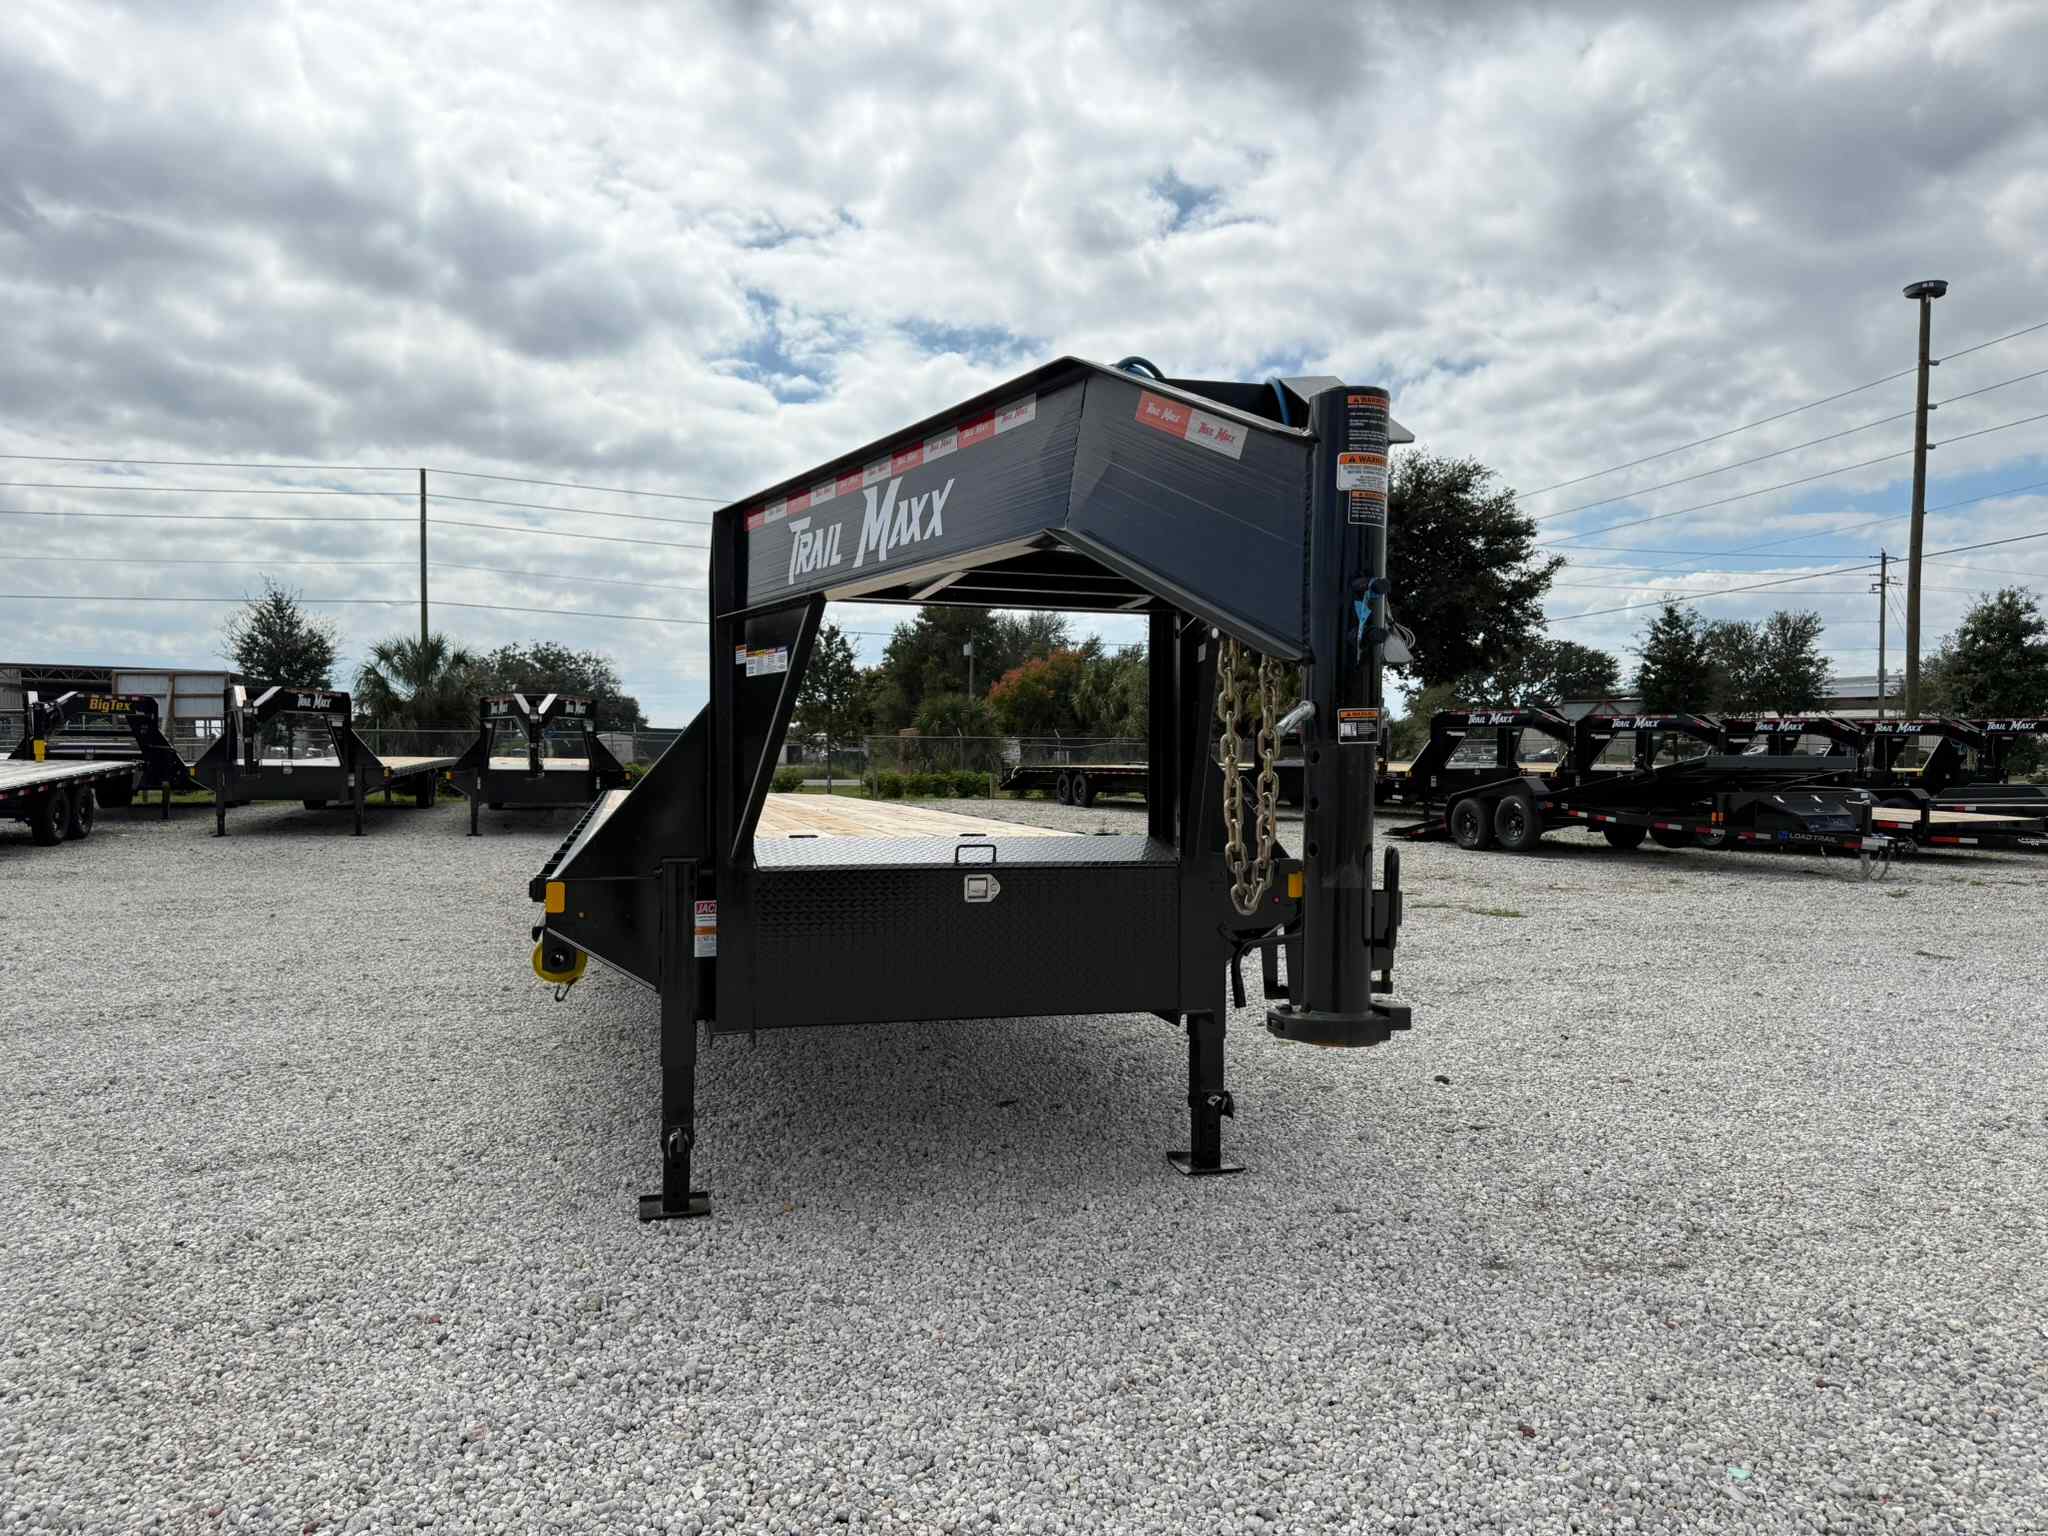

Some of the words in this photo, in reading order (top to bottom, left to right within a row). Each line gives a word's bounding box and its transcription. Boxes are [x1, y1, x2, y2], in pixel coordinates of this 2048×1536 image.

[788, 516, 842, 585] TRAIL
[852, 476, 956, 568] MAXX
[1488, 710, 1514, 725] MAXX
[1632, 716, 1660, 729] MAXX
[2008, 719, 2038, 731] MAXX
[695, 902, 717, 914] JAC
